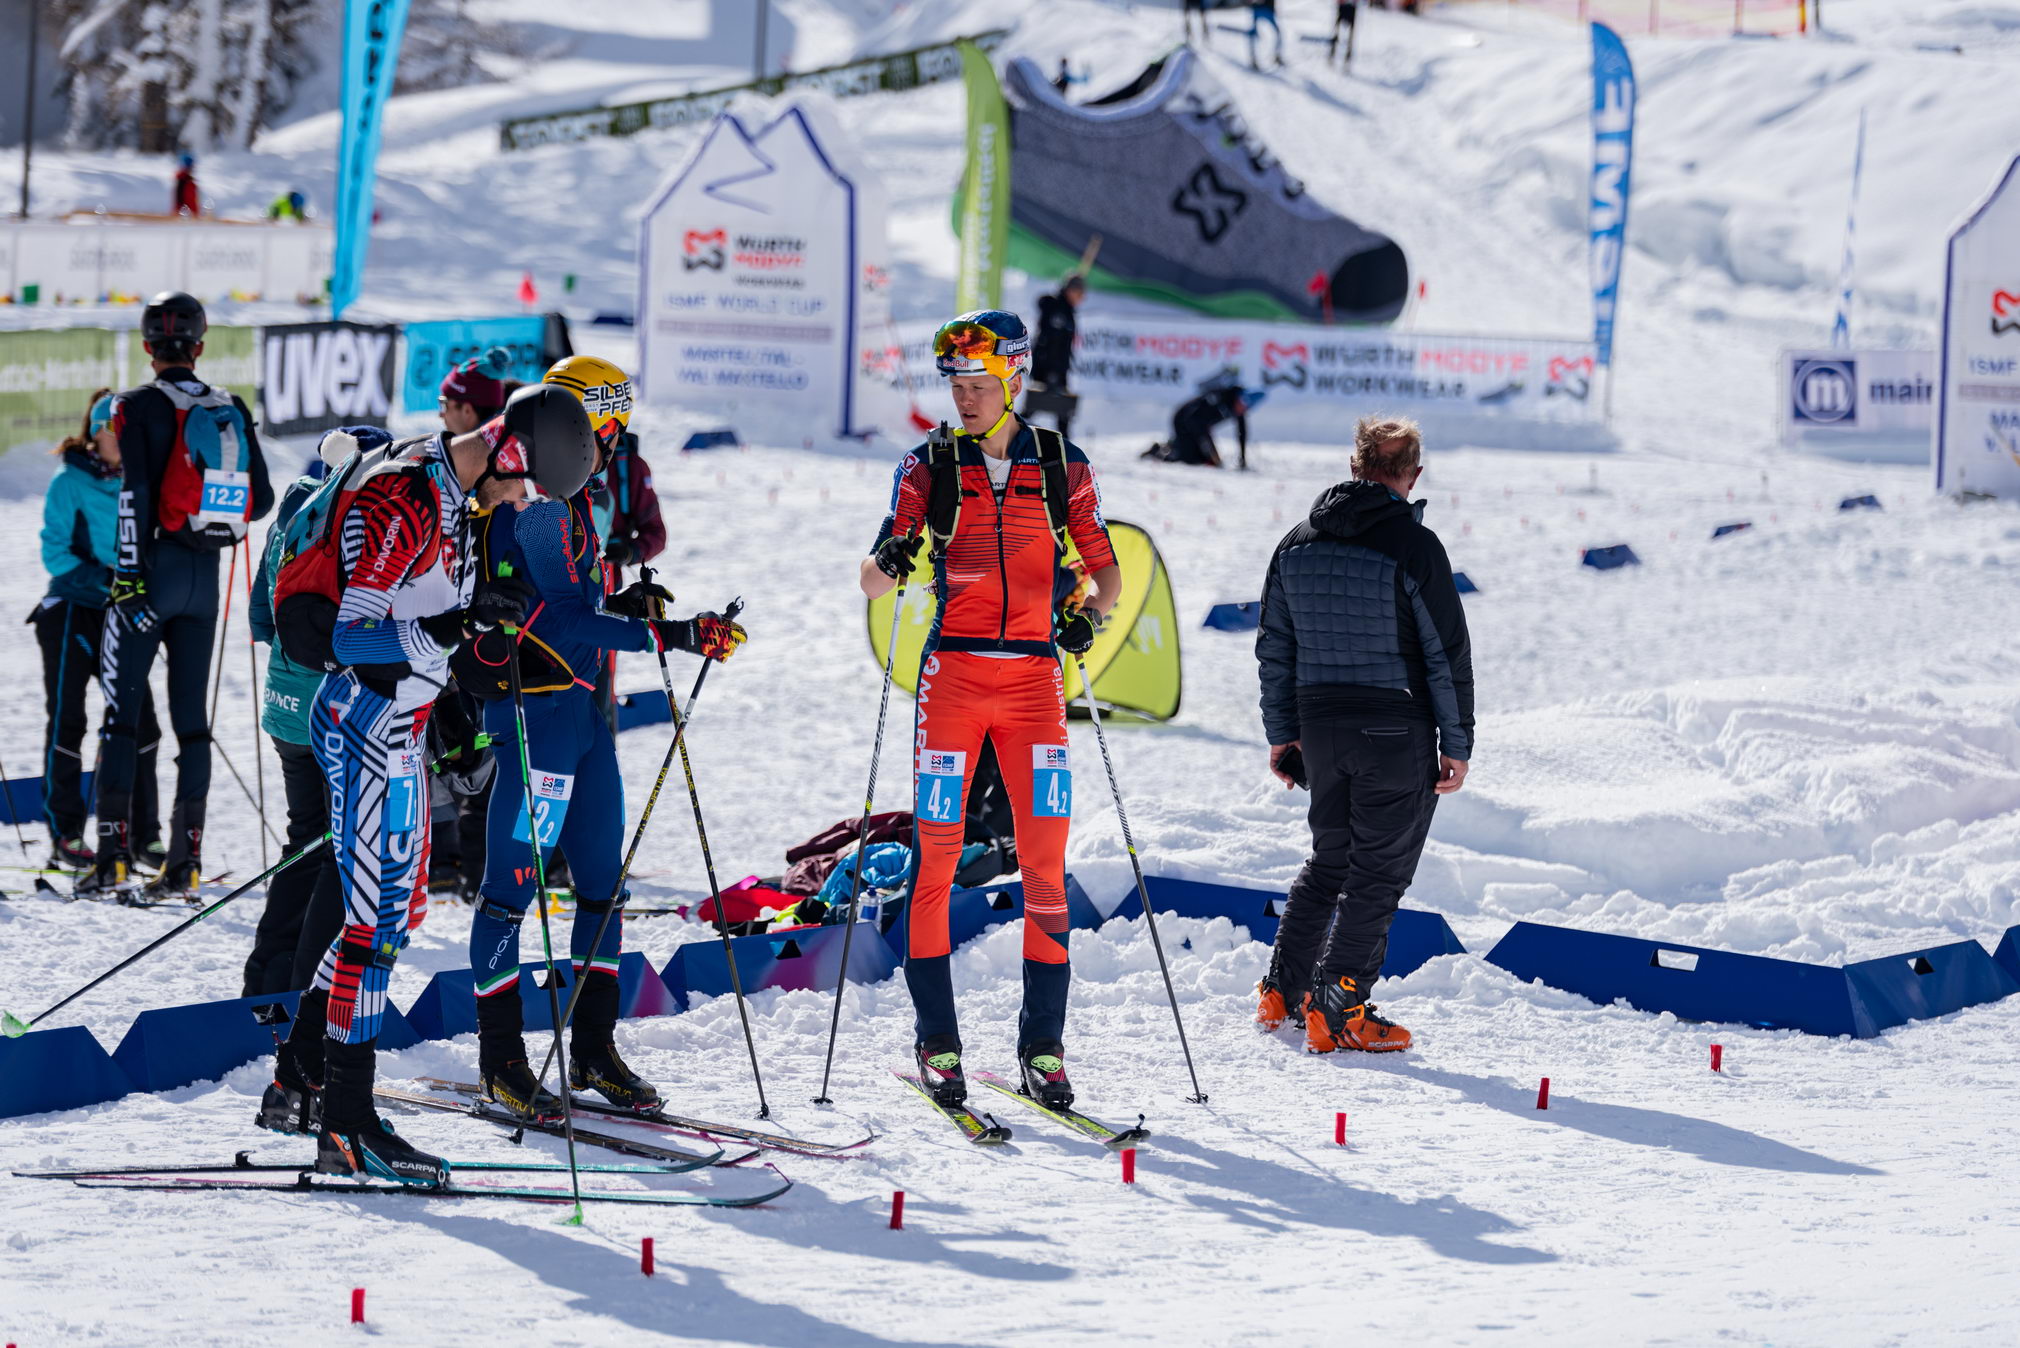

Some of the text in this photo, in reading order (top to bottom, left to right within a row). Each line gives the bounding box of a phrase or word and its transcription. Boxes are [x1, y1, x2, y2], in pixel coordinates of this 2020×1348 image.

[266, 329, 390, 425] uvex
[1420, 350, 1531, 374] MODYF
[1968, 358, 2017, 376] ISMF
[207, 486, 245, 507] 12.2
[117, 490, 138, 567] USA
[374, 515, 402, 573] DAVORIN
[557, 517, 580, 585] KARPOS
[1053, 665, 1067, 729] Austria
[324, 731, 345, 864] DAVORIN
[927, 778, 951, 820] 4.2
[1047, 772, 1067, 814] 4.2
[391, 1160, 437, 1173] SCARPA
